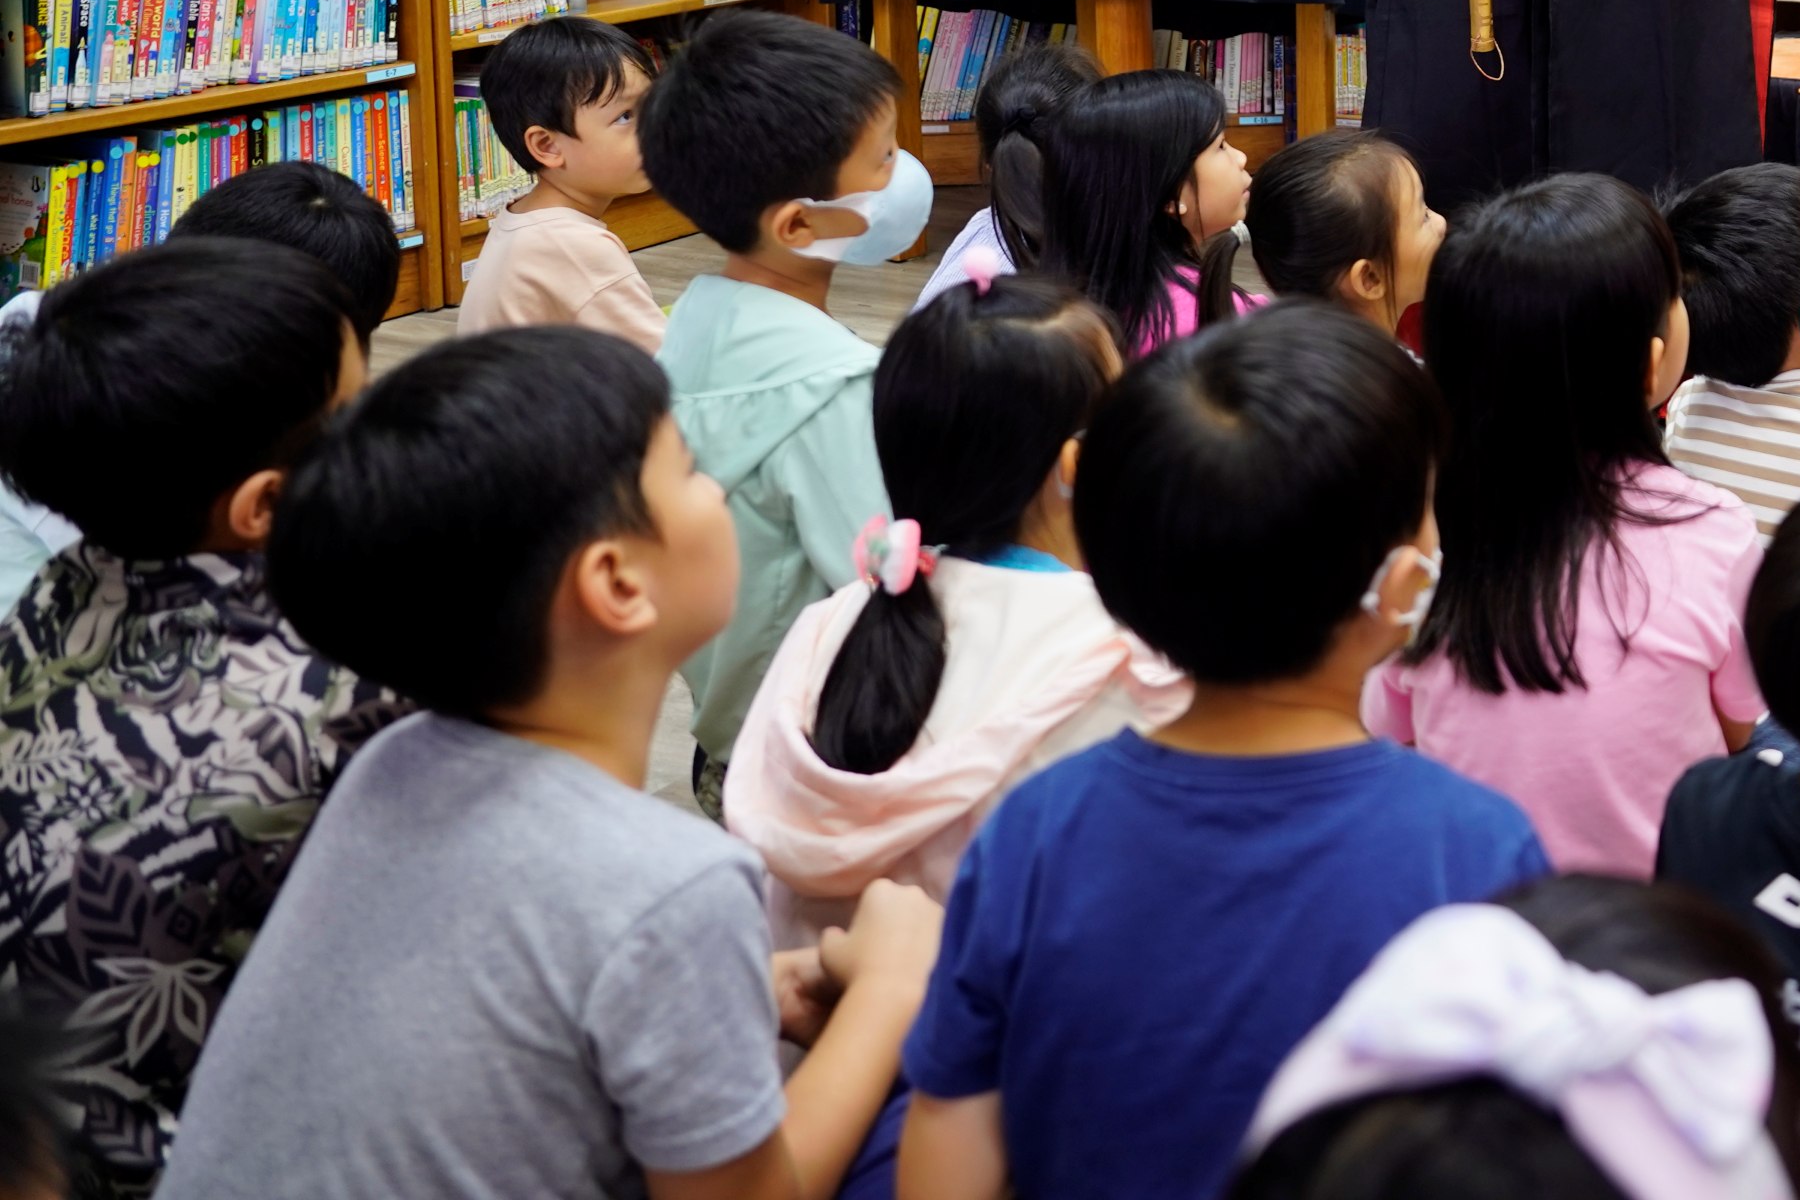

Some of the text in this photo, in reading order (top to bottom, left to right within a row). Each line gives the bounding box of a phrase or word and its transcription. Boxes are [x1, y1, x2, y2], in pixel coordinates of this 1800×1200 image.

[106, 5, 117, 26] Food
[59, 10, 69, 44] Animals
[385, 68, 397, 78] E-7
